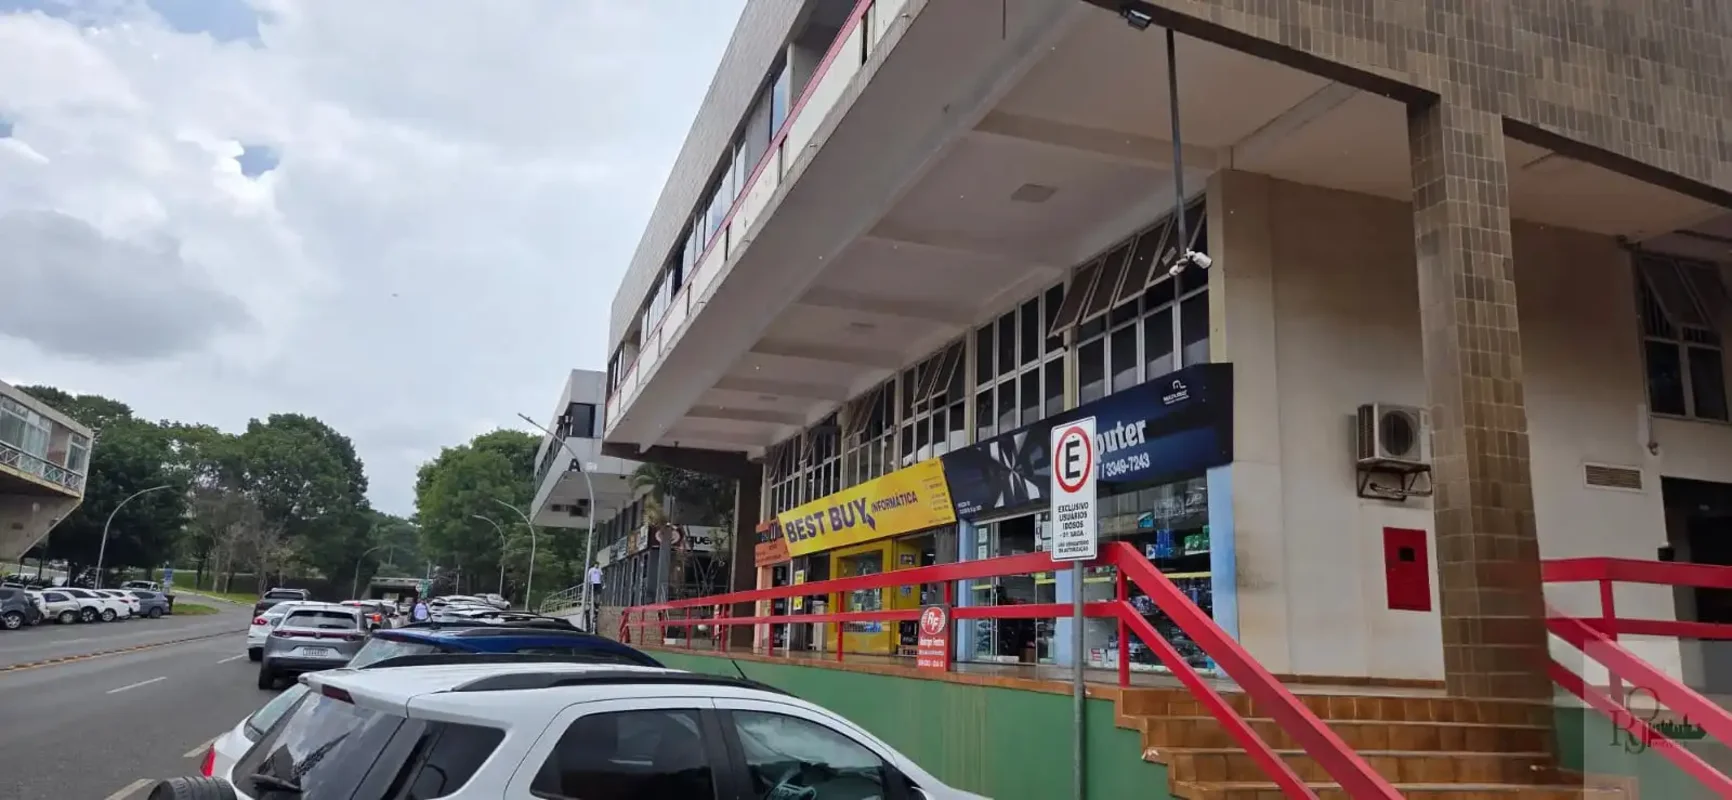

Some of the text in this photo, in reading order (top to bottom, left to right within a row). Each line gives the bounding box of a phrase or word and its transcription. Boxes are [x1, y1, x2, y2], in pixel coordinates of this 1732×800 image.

[568, 458, 581, 472] A
[1065, 440, 1081, 479] E
[1105, 452, 1150, 477] 3349-7243
[871, 491, 918, 513] INFORMÁTICA
[1058, 502, 1089, 513] EXCLUSIVO
[785, 511, 825, 543] BEST
[828, 497, 867, 532] BUY
[1062, 521, 1084, 530] IDOSOS
[927, 611, 939, 632] RF
